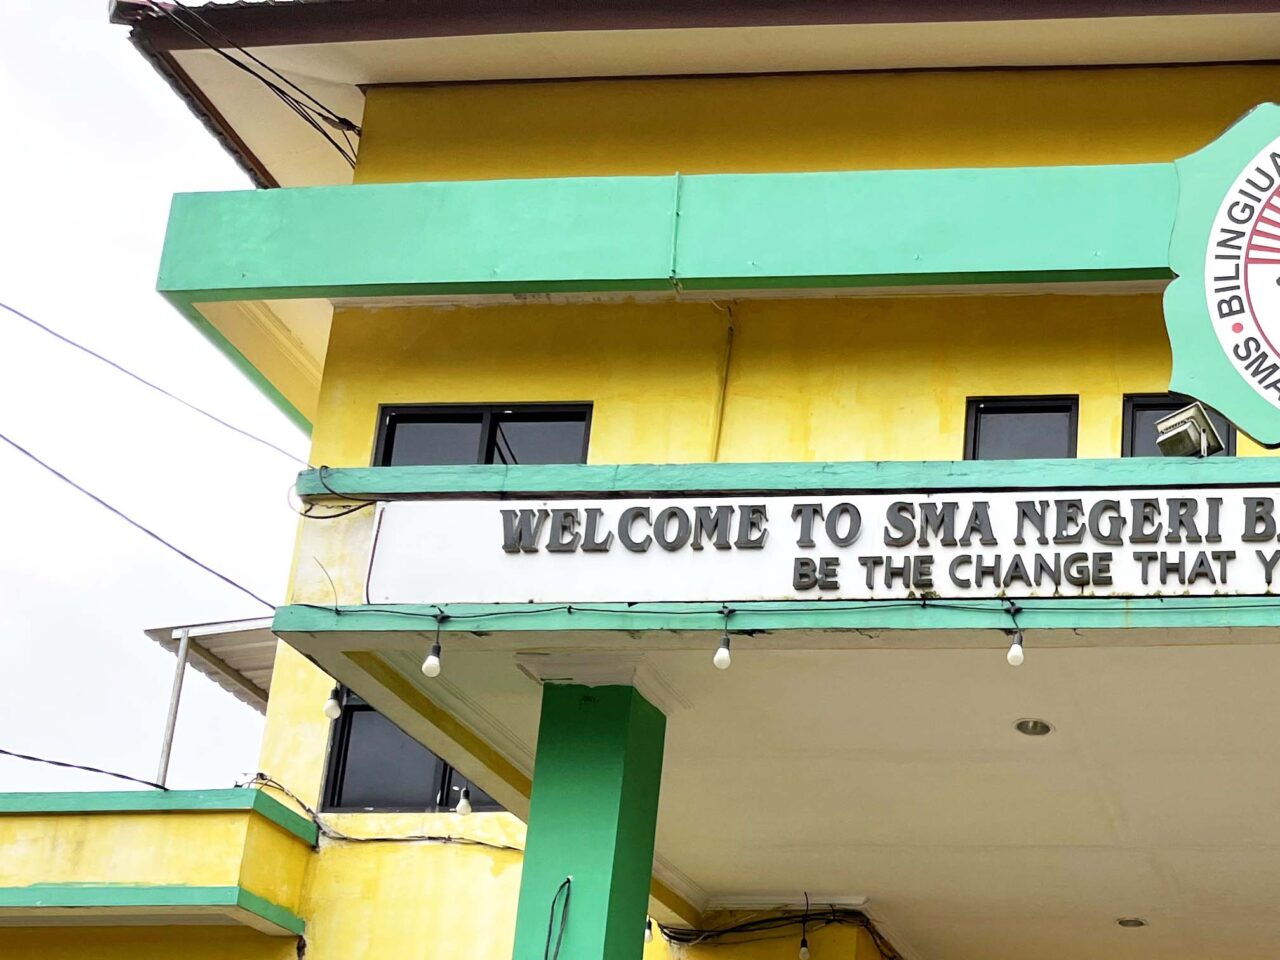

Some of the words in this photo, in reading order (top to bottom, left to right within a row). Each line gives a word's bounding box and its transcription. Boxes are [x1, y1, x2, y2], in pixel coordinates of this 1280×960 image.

[500, 504, 770, 553] WELCOME
[791, 502, 863, 548] TO
[884, 501, 999, 548] SMA
[1013, 497, 1225, 546] NEGERI
[792, 556, 841, 590] BE
[858, 554, 934, 589] THE
[948, 552, 1114, 588] CHANGE
[1133, 550, 1236, 585] THAT
